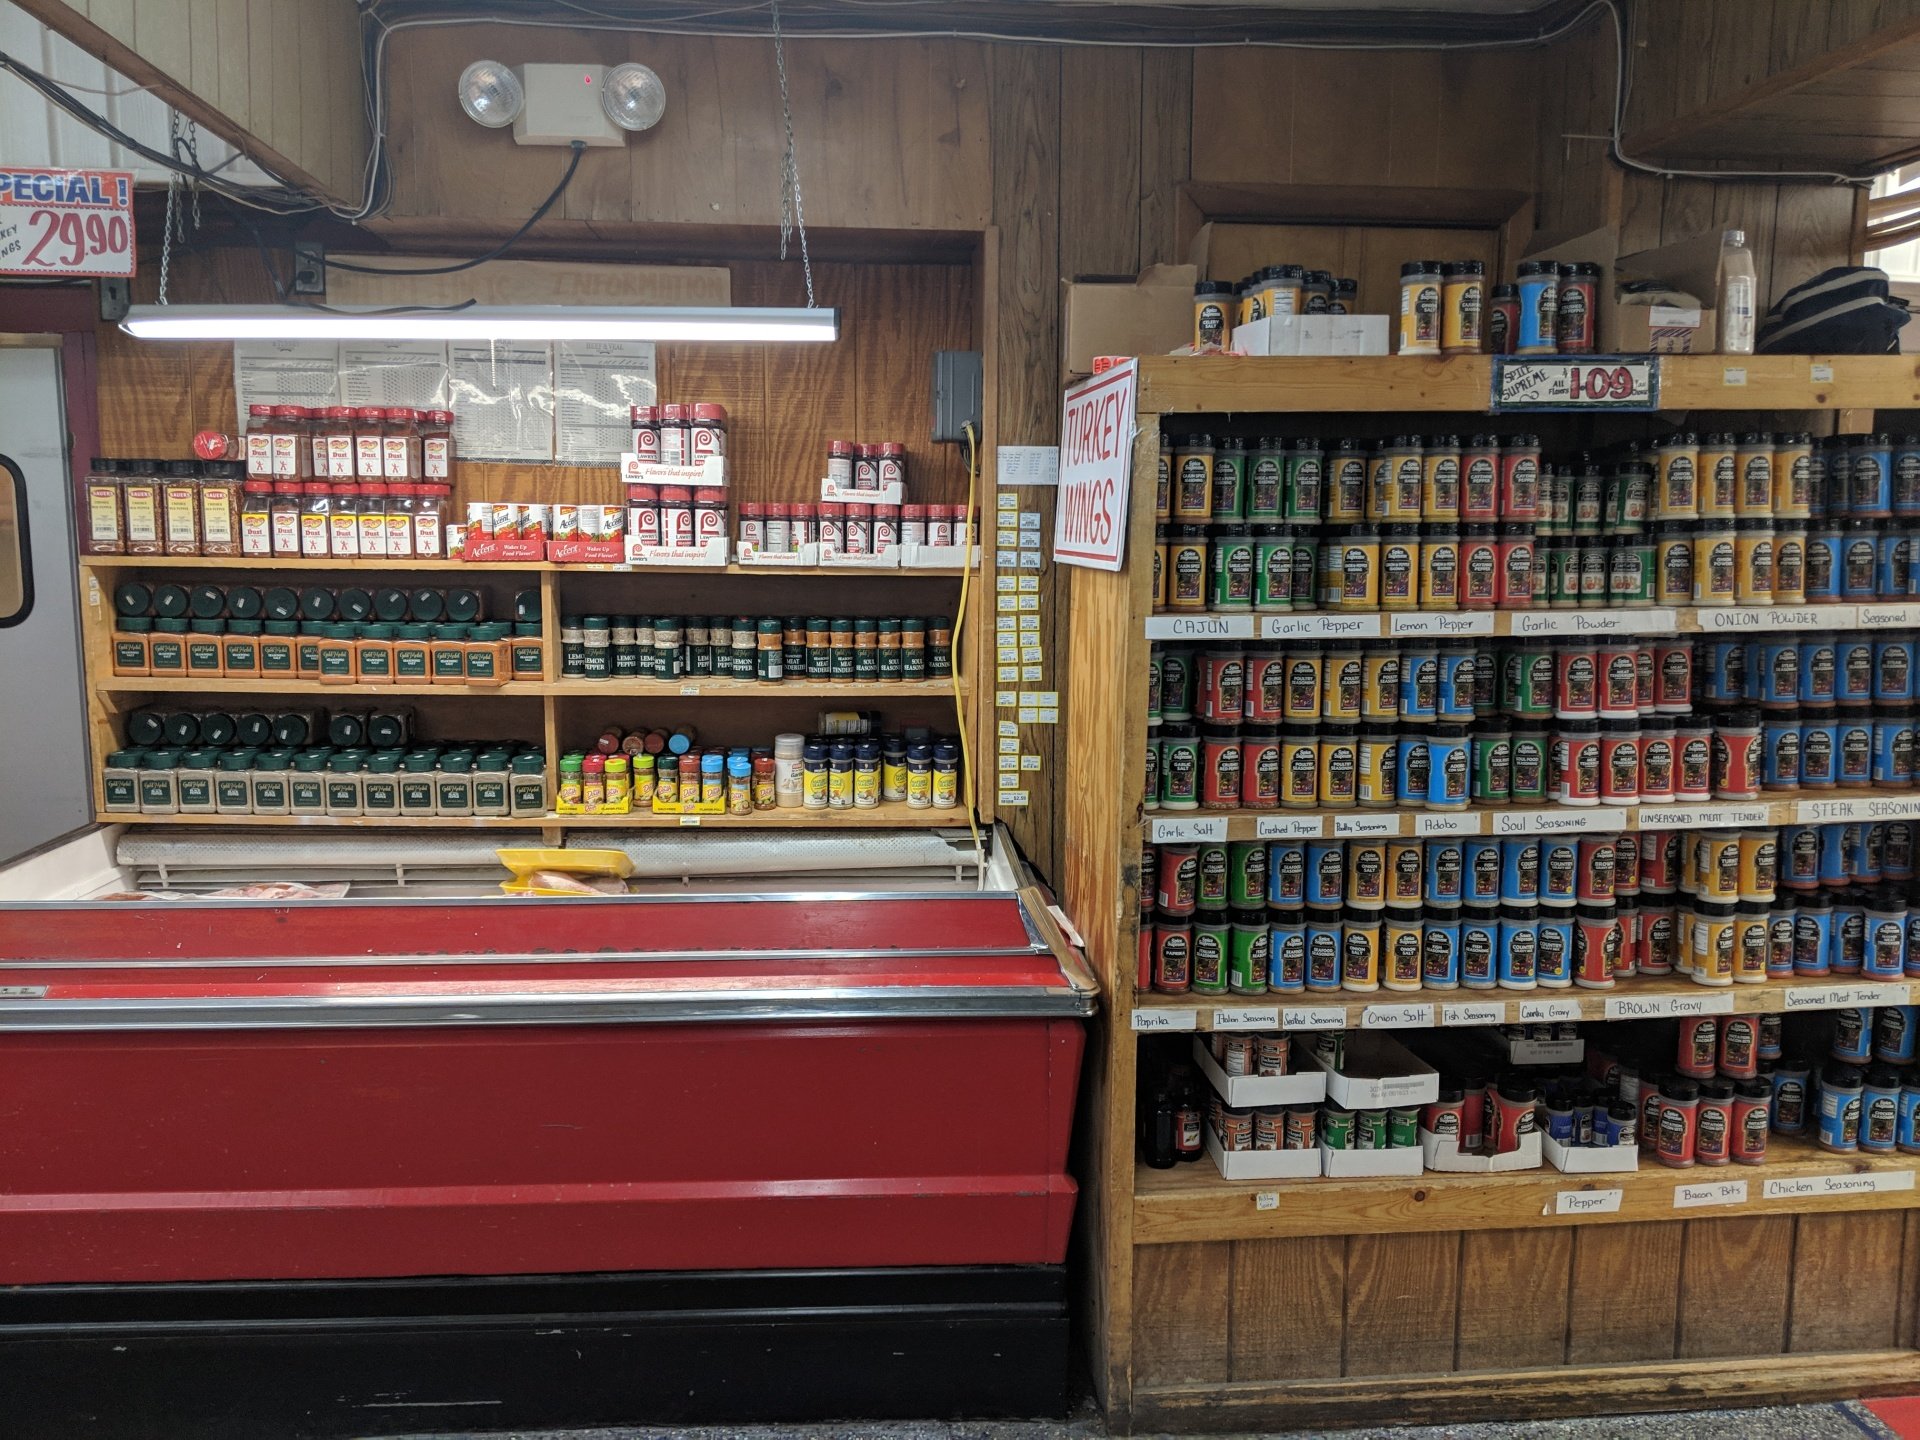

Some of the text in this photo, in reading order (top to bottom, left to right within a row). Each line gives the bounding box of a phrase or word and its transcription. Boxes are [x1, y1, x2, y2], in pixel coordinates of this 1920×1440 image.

[22, 210, 128, 266] 29.90
[1503, 365, 1533, 384] SPICE
[1502, 369, 1549, 400] SUPREME
[1067, 388, 1127, 467] TURKEY
[1064, 478, 1114, 545] WINGS
[472, 544, 496, 557] Accent
[554, 544, 578, 558] Accent
[1395, 615, 1474, 632] Lemon Pepper
[1522, 614, 1620, 632] Garlic Powder
[1714, 612, 1818, 626] ONION POWDER
[1862, 609, 1906, 625] Seasoned
[1173, 619, 1229, 634] CAJUN
[1272, 617, 1364, 634] Garlic Pepper
[1812, 802, 1854, 818] STEAK
[1425, 818, 1458, 831] Adobo
[1502, 815, 1526, 832] Soul
[1640, 814, 1692, 824] UNSEASONED
[1700, 812, 1724, 822] MEAT
[1158, 824, 1213, 838] Garlic Salt
[1260, 821, 1318, 834] Crushed Pepper
[1356, 820, 1387, 832] Seasoning
[1788, 991, 1882, 1006] Seasoned Meat Tender
[1548, 1005, 1570, 1018] Gravy
[1615, 999, 1702, 1014] BROWN Gravy
[1135, 1014, 1170, 1028] Paprika
[1243, 1012, 1275, 1023] Seasoning
[1310, 1012, 1343, 1026] Seasoning
[1368, 1010, 1427, 1024] Onion Salt
[1444, 1008, 1496, 1022] Fish Seasoning
[1682, 1186, 1741, 1200] Bacon Bits
[1770, 1178, 1876, 1195] Chicken Seasoning
[1564, 1195, 1606, 1208] Pepper
